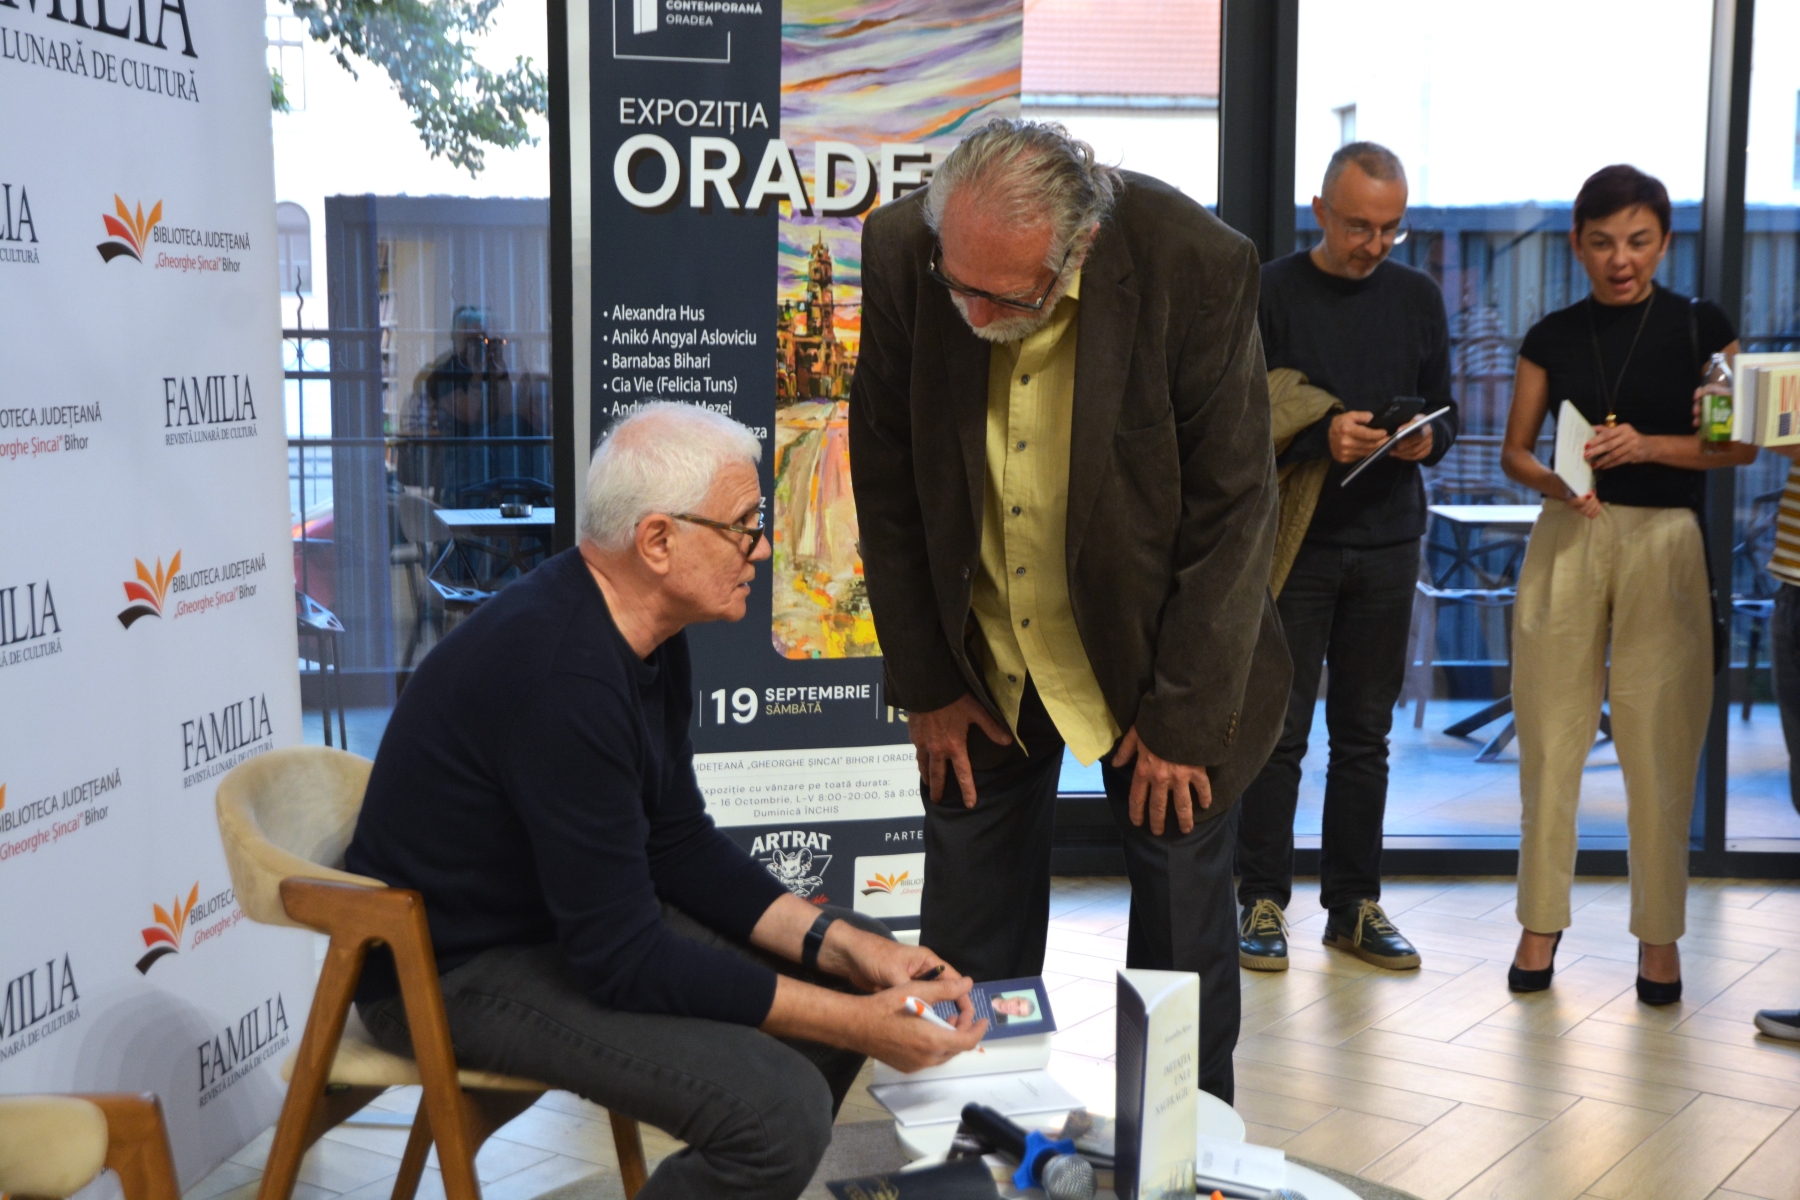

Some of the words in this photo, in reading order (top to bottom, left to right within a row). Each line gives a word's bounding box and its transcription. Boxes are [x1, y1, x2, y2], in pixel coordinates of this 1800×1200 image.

[665, 13, 714, 27] ORADEA
[1, 27, 89, 77] LUNARĂ
[92, 50, 118, 84] DE
[121, 57, 200, 102] CULTURĂ
[620, 97, 769, 135] EXPOZIȚIA
[0, 183, 39, 243] IA
[153, 225, 203, 246] BIBLIOTECA
[222, 257, 241, 273] Bihor
[612, 304, 677, 322] Alexandra
[680, 305, 705, 322] Hus
[612, 328, 649, 345] Anikó
[652, 329, 697, 349] Angyal
[700, 329, 757, 346] Asloviciu
[612, 353, 671, 369] Barnabas
[674, 353, 711, 369] Bihari
[611, 377, 632, 393] Cia
[633, 377, 654, 393] Vie
[656, 376, 701, 394] (Felicia
[703, 376, 738, 394] Tuns)
[162, 372, 257, 428] FAMILIA
[64, 432, 89, 451] Bihor
[165, 429, 194, 446] REVISTĂ
[194, 426, 221, 443] LUNARĂ
[221, 427, 230, 440] DE
[230, 422, 258, 439] CULTURĂ
[172, 566, 221, 594] BIBLIOTECA
[239, 583, 257, 600] Bihor
[0, 578, 62, 647] ILIA
[9, 649, 22, 665] DE
[23, 637, 63, 662] CULTURĂ
[710, 686, 759, 725] 19
[765, 684, 871, 702] SEPTEMBRIE
[181, 690, 274, 771] FAMILIA
[845, 755, 875, 765] BIHOR
[699, 783, 746, 796] xpoziție
[749, 785, 762, 793] cu
[766, 782, 805, 793] vânzare
[808, 783, 821, 792] pe
[825, 780, 852, 789] toată
[855, 779, 891, 788] durata:
[0, 794, 59, 834] IBLIOTECA
[721, 798, 731, 807] 16
[753, 806, 801, 818] Duminică
[804, 804, 839, 815] ÎNCHIS
[84, 805, 109, 827] Bihor
[750, 830, 832, 857] ARTRAT
[885, 829, 924, 842] PARTE
[27, 1028, 41, 1047] DE
[41, 1003, 81, 1039] CULTURĂ
[197, 990, 289, 1093] FAMILIA
[262, 1032, 290, 1060] CULTURĂ
